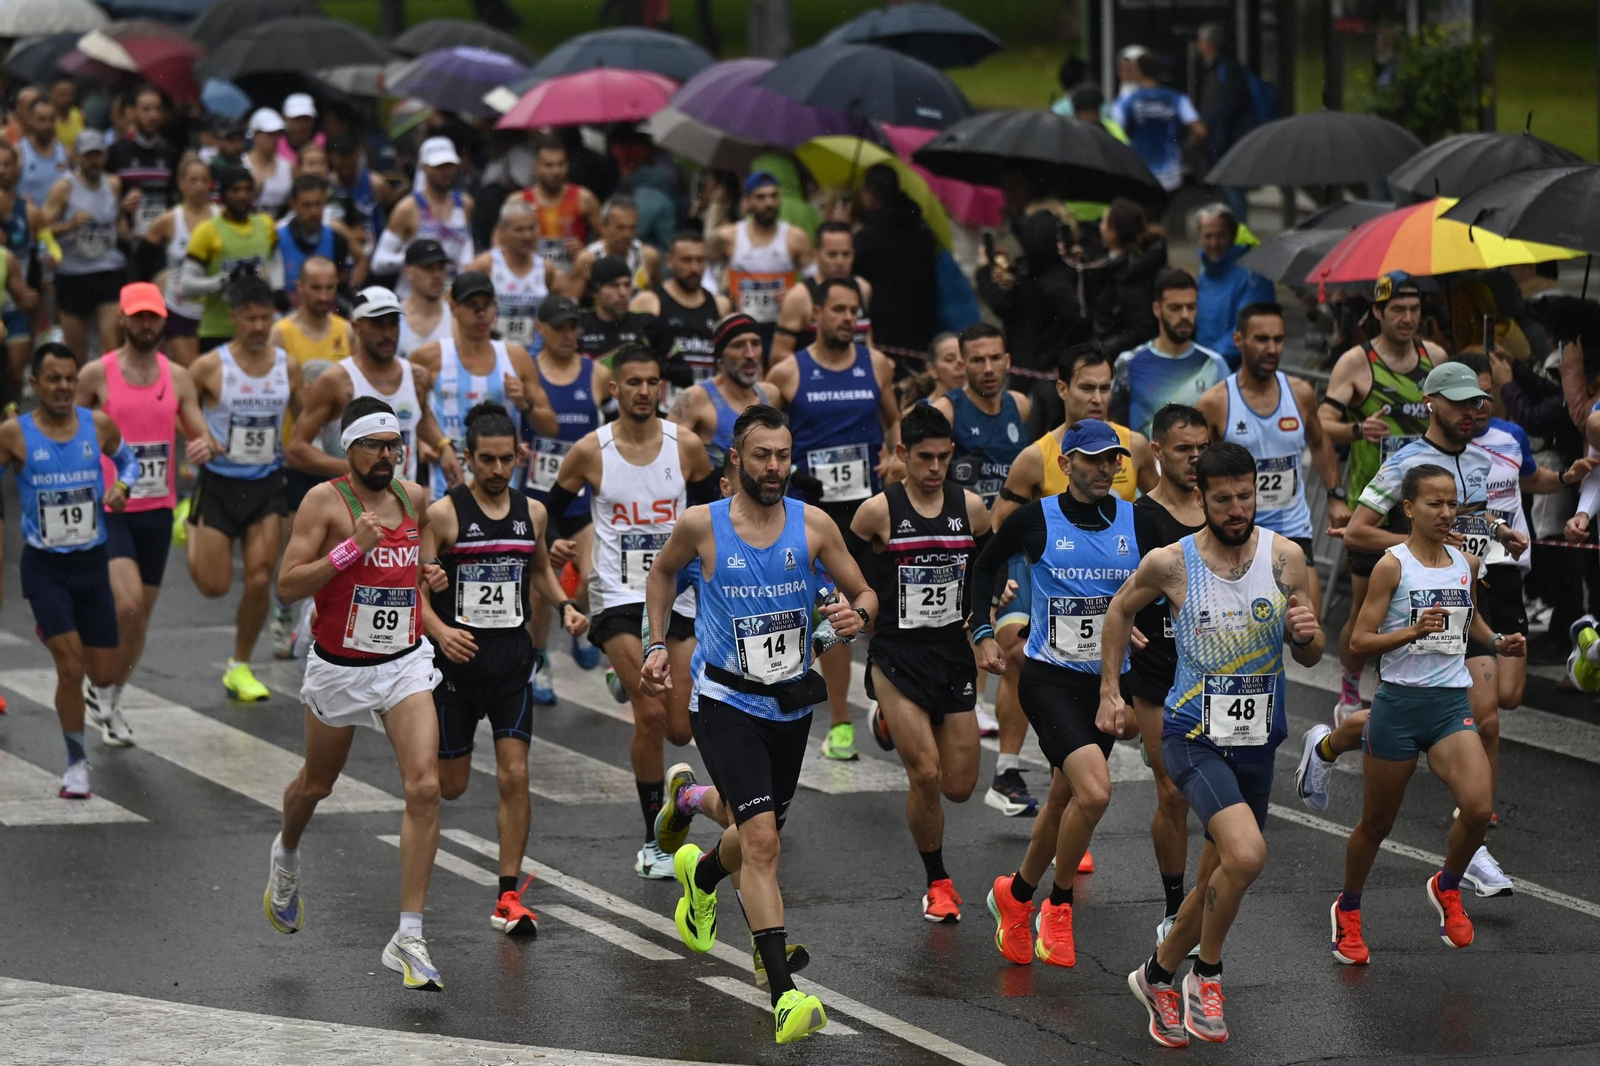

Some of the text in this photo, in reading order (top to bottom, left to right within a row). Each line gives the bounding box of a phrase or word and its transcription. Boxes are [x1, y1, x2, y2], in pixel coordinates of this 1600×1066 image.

[806, 389, 875, 403] TROTASIERRA
[244, 431, 267, 447] 55
[830, 464, 852, 483] 15
[1258, 474, 1282, 491] 22
[60, 506, 82, 526] 19
[364, 545, 420, 568] KENYA
[727, 553, 747, 569] als
[479, 585, 504, 605] 24
[722, 580, 807, 598] TROTASIERRA
[921, 587, 947, 606] 25
[372, 609, 399, 631] 69
[770, 612, 794, 621] MEDIA
[1080, 618, 1094, 639] 5
[763, 634, 786, 659] 14
[1242, 676, 1264, 684] MEDIA
[1227, 698, 1256, 721] 48
